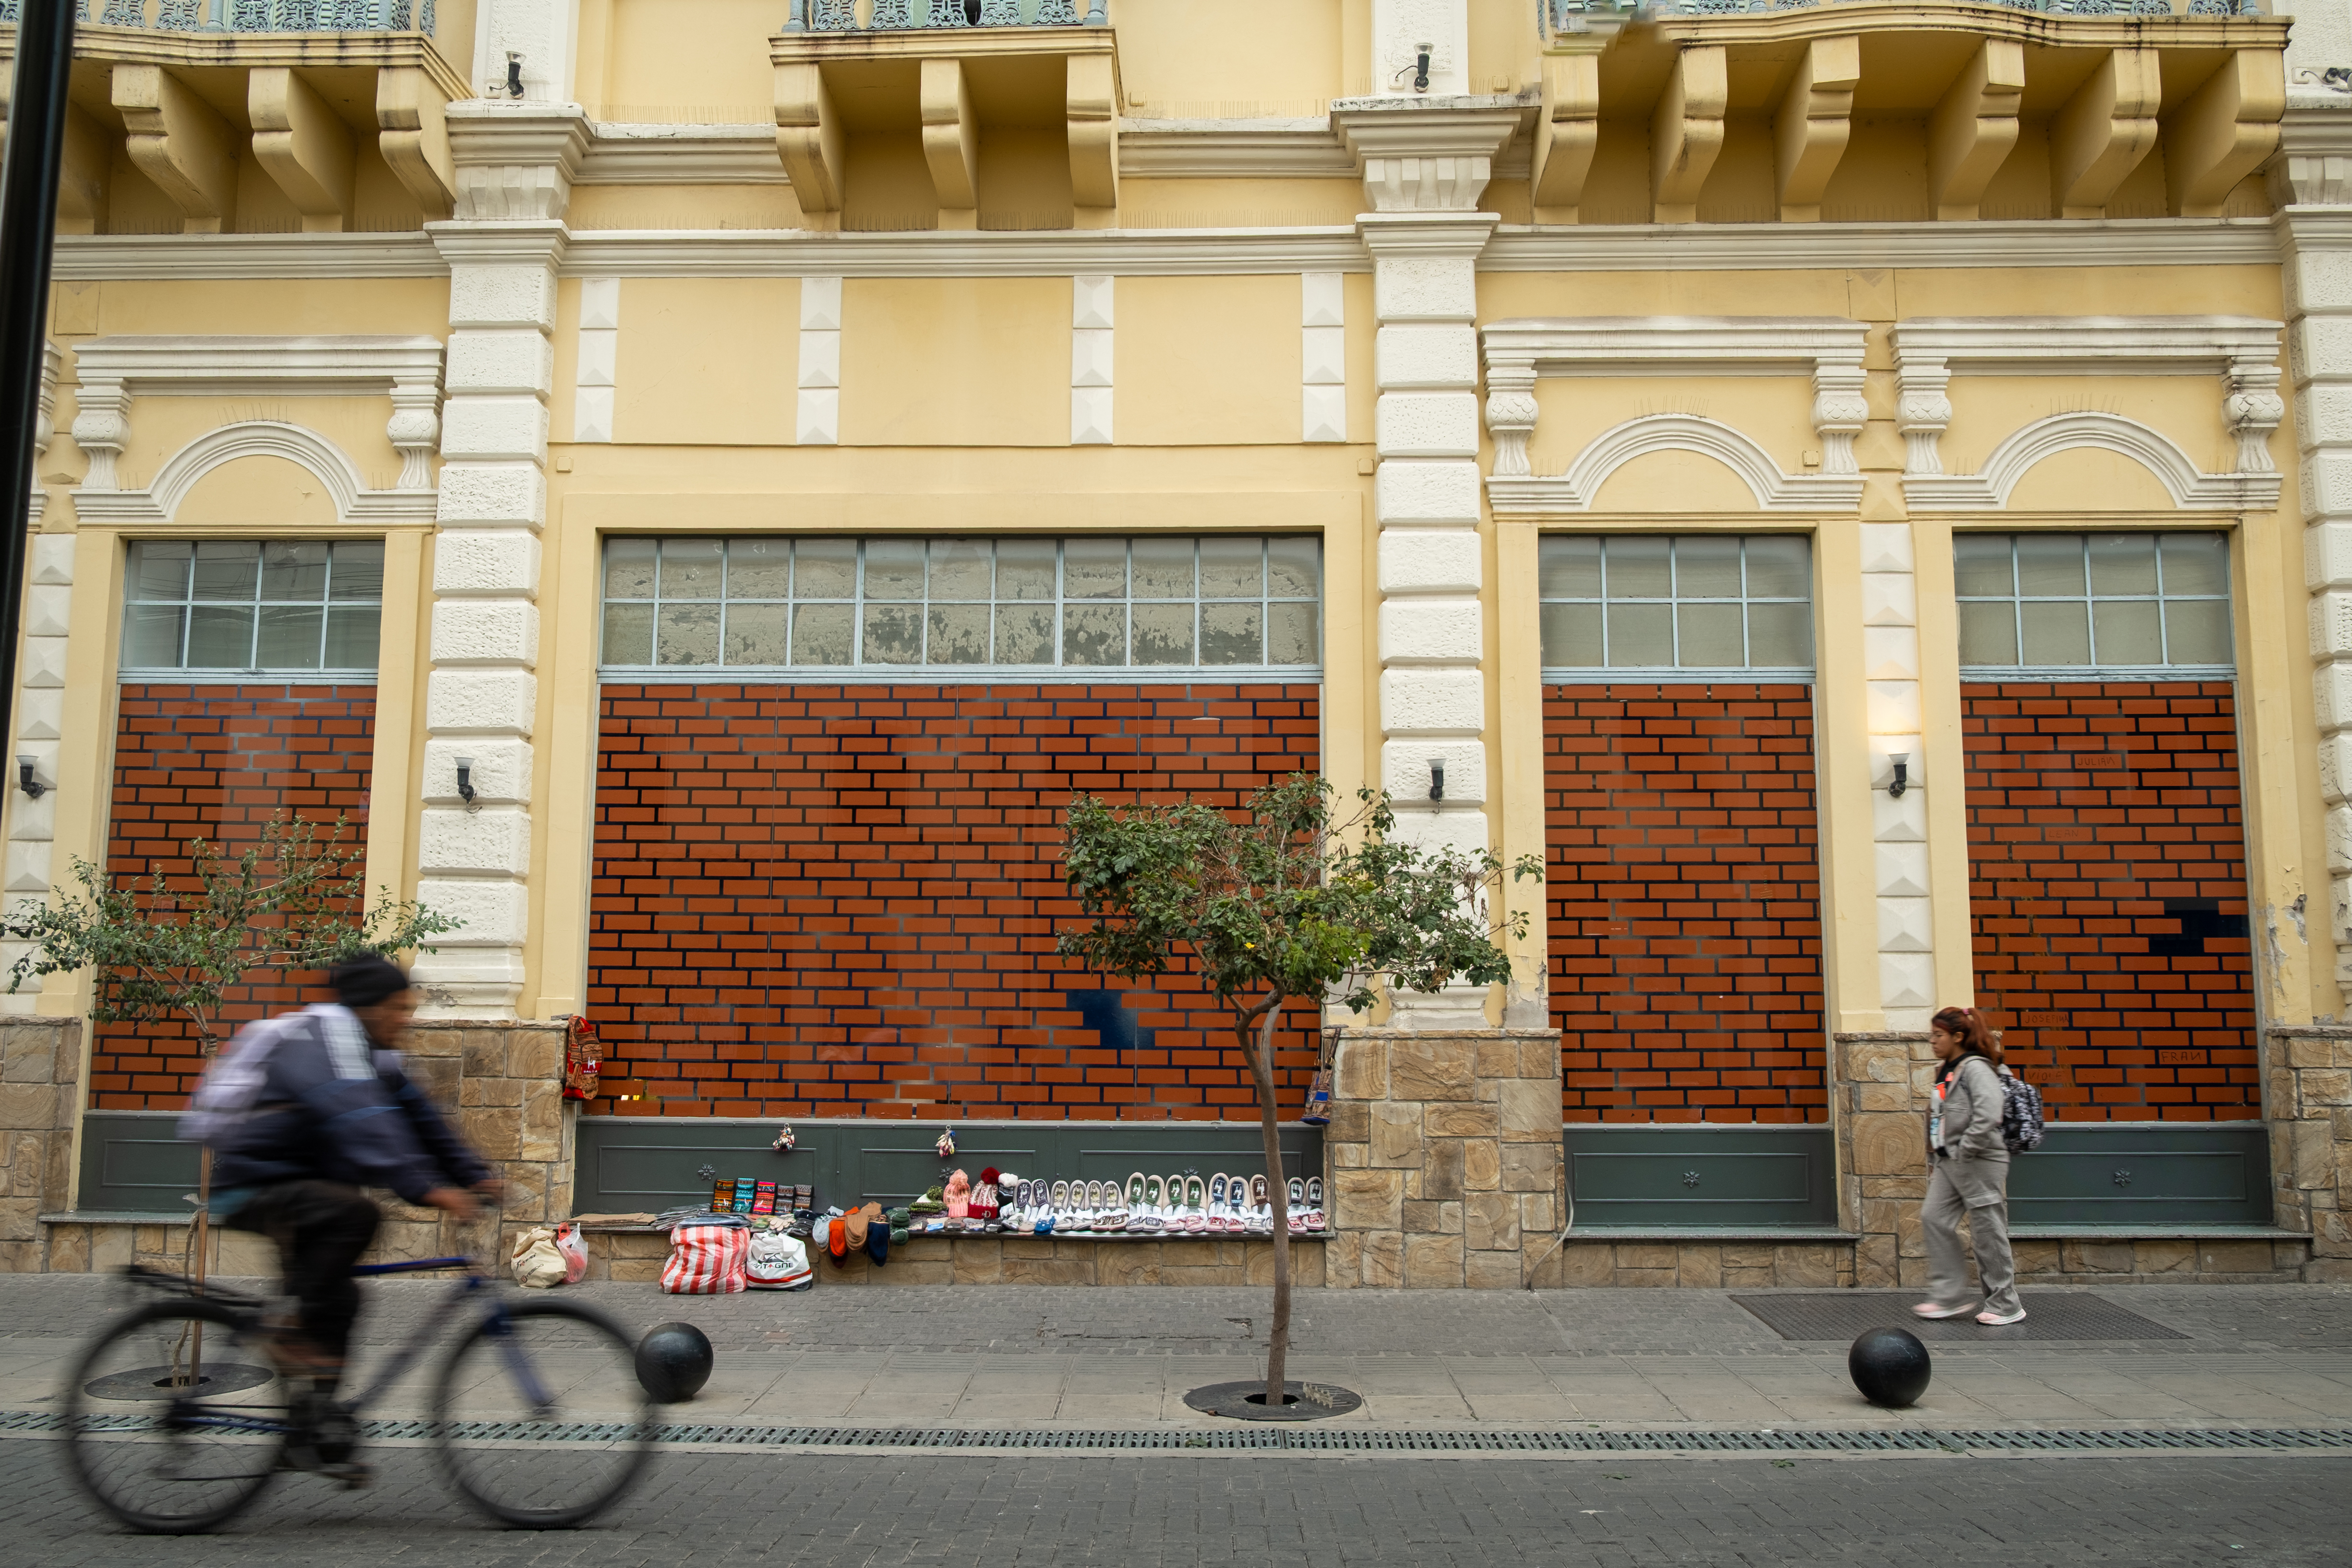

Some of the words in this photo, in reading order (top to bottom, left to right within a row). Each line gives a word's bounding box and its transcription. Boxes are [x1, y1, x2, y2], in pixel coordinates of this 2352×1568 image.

[2049, 829, 2079, 838] LEAN
[2024, 1013, 2070, 1024] JOSEFINA
[2160, 1051, 2202, 1063] FRAN
